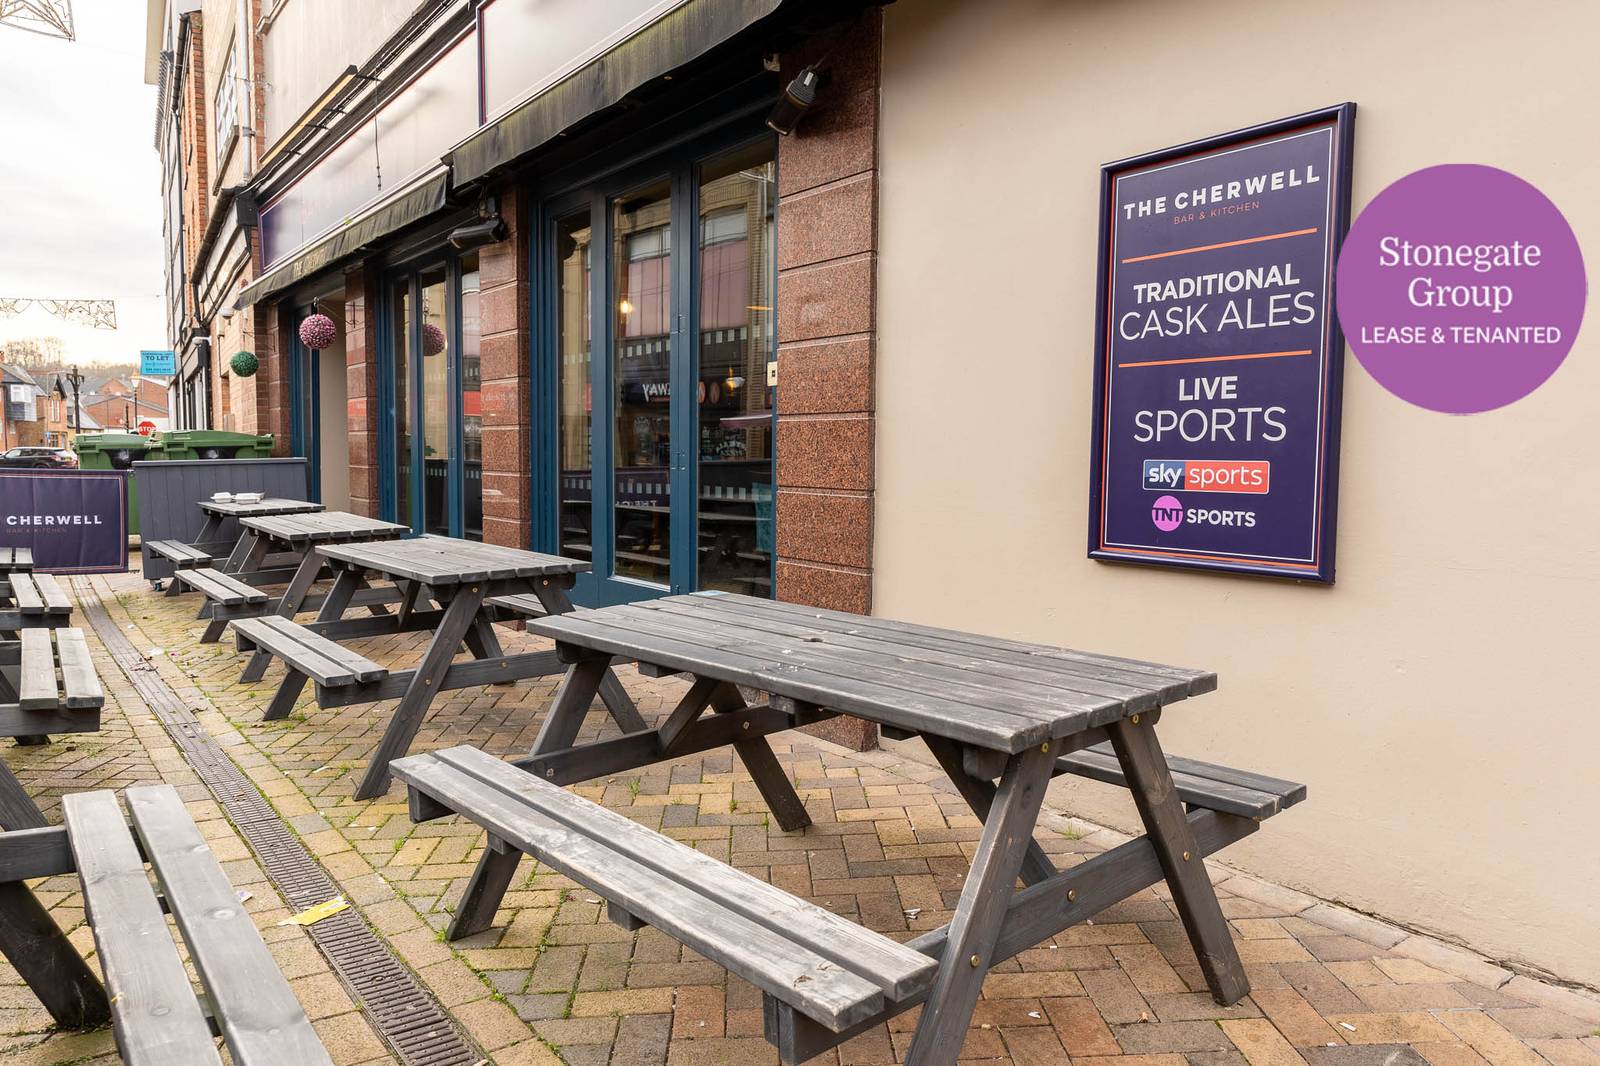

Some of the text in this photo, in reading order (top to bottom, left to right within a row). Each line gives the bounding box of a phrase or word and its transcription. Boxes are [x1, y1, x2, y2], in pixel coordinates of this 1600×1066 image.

[1124, 165, 1320, 220] THE CHERWELL
[1173, 201, 1260, 225] BAR & KITCHEN
[1133, 263, 1300, 304] TRADITIONAL
[1119, 291, 1316, 341] CASK ALES
[1179, 375, 1238, 401] LIVE
[1133, 406, 1287, 442] SPORTS
[1149, 463, 1263, 488] sky sports
[6, 515, 102, 526] CHERWELL
[1152, 507, 1256, 527] TNT SPORTS
